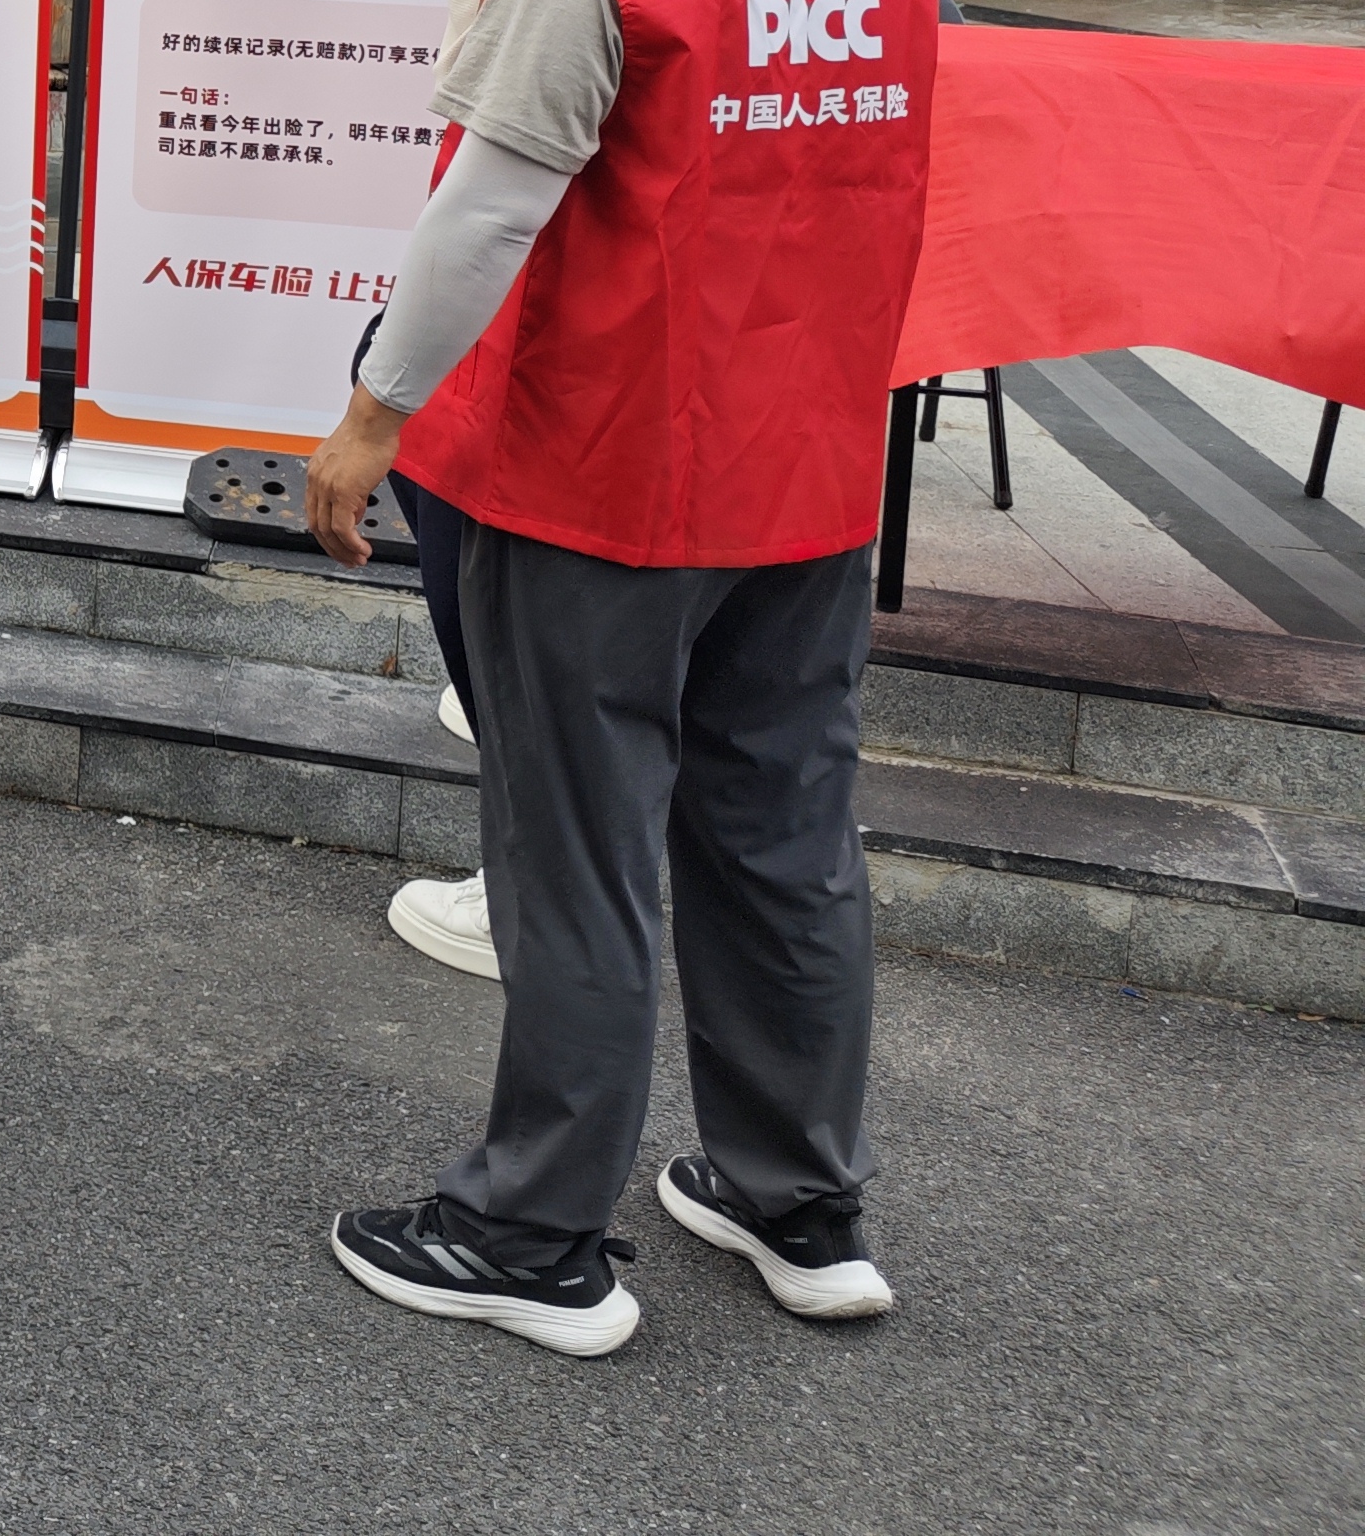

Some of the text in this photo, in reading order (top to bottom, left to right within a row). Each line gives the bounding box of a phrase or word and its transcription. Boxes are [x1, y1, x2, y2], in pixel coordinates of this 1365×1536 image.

[159, 87, 231, 107] 一句话：
[709, 82, 909, 134] 中国人民保险
[158, 136, 334, 166] 司还愿不愿意承保。
[143, 256, 314, 298] 人保车险
